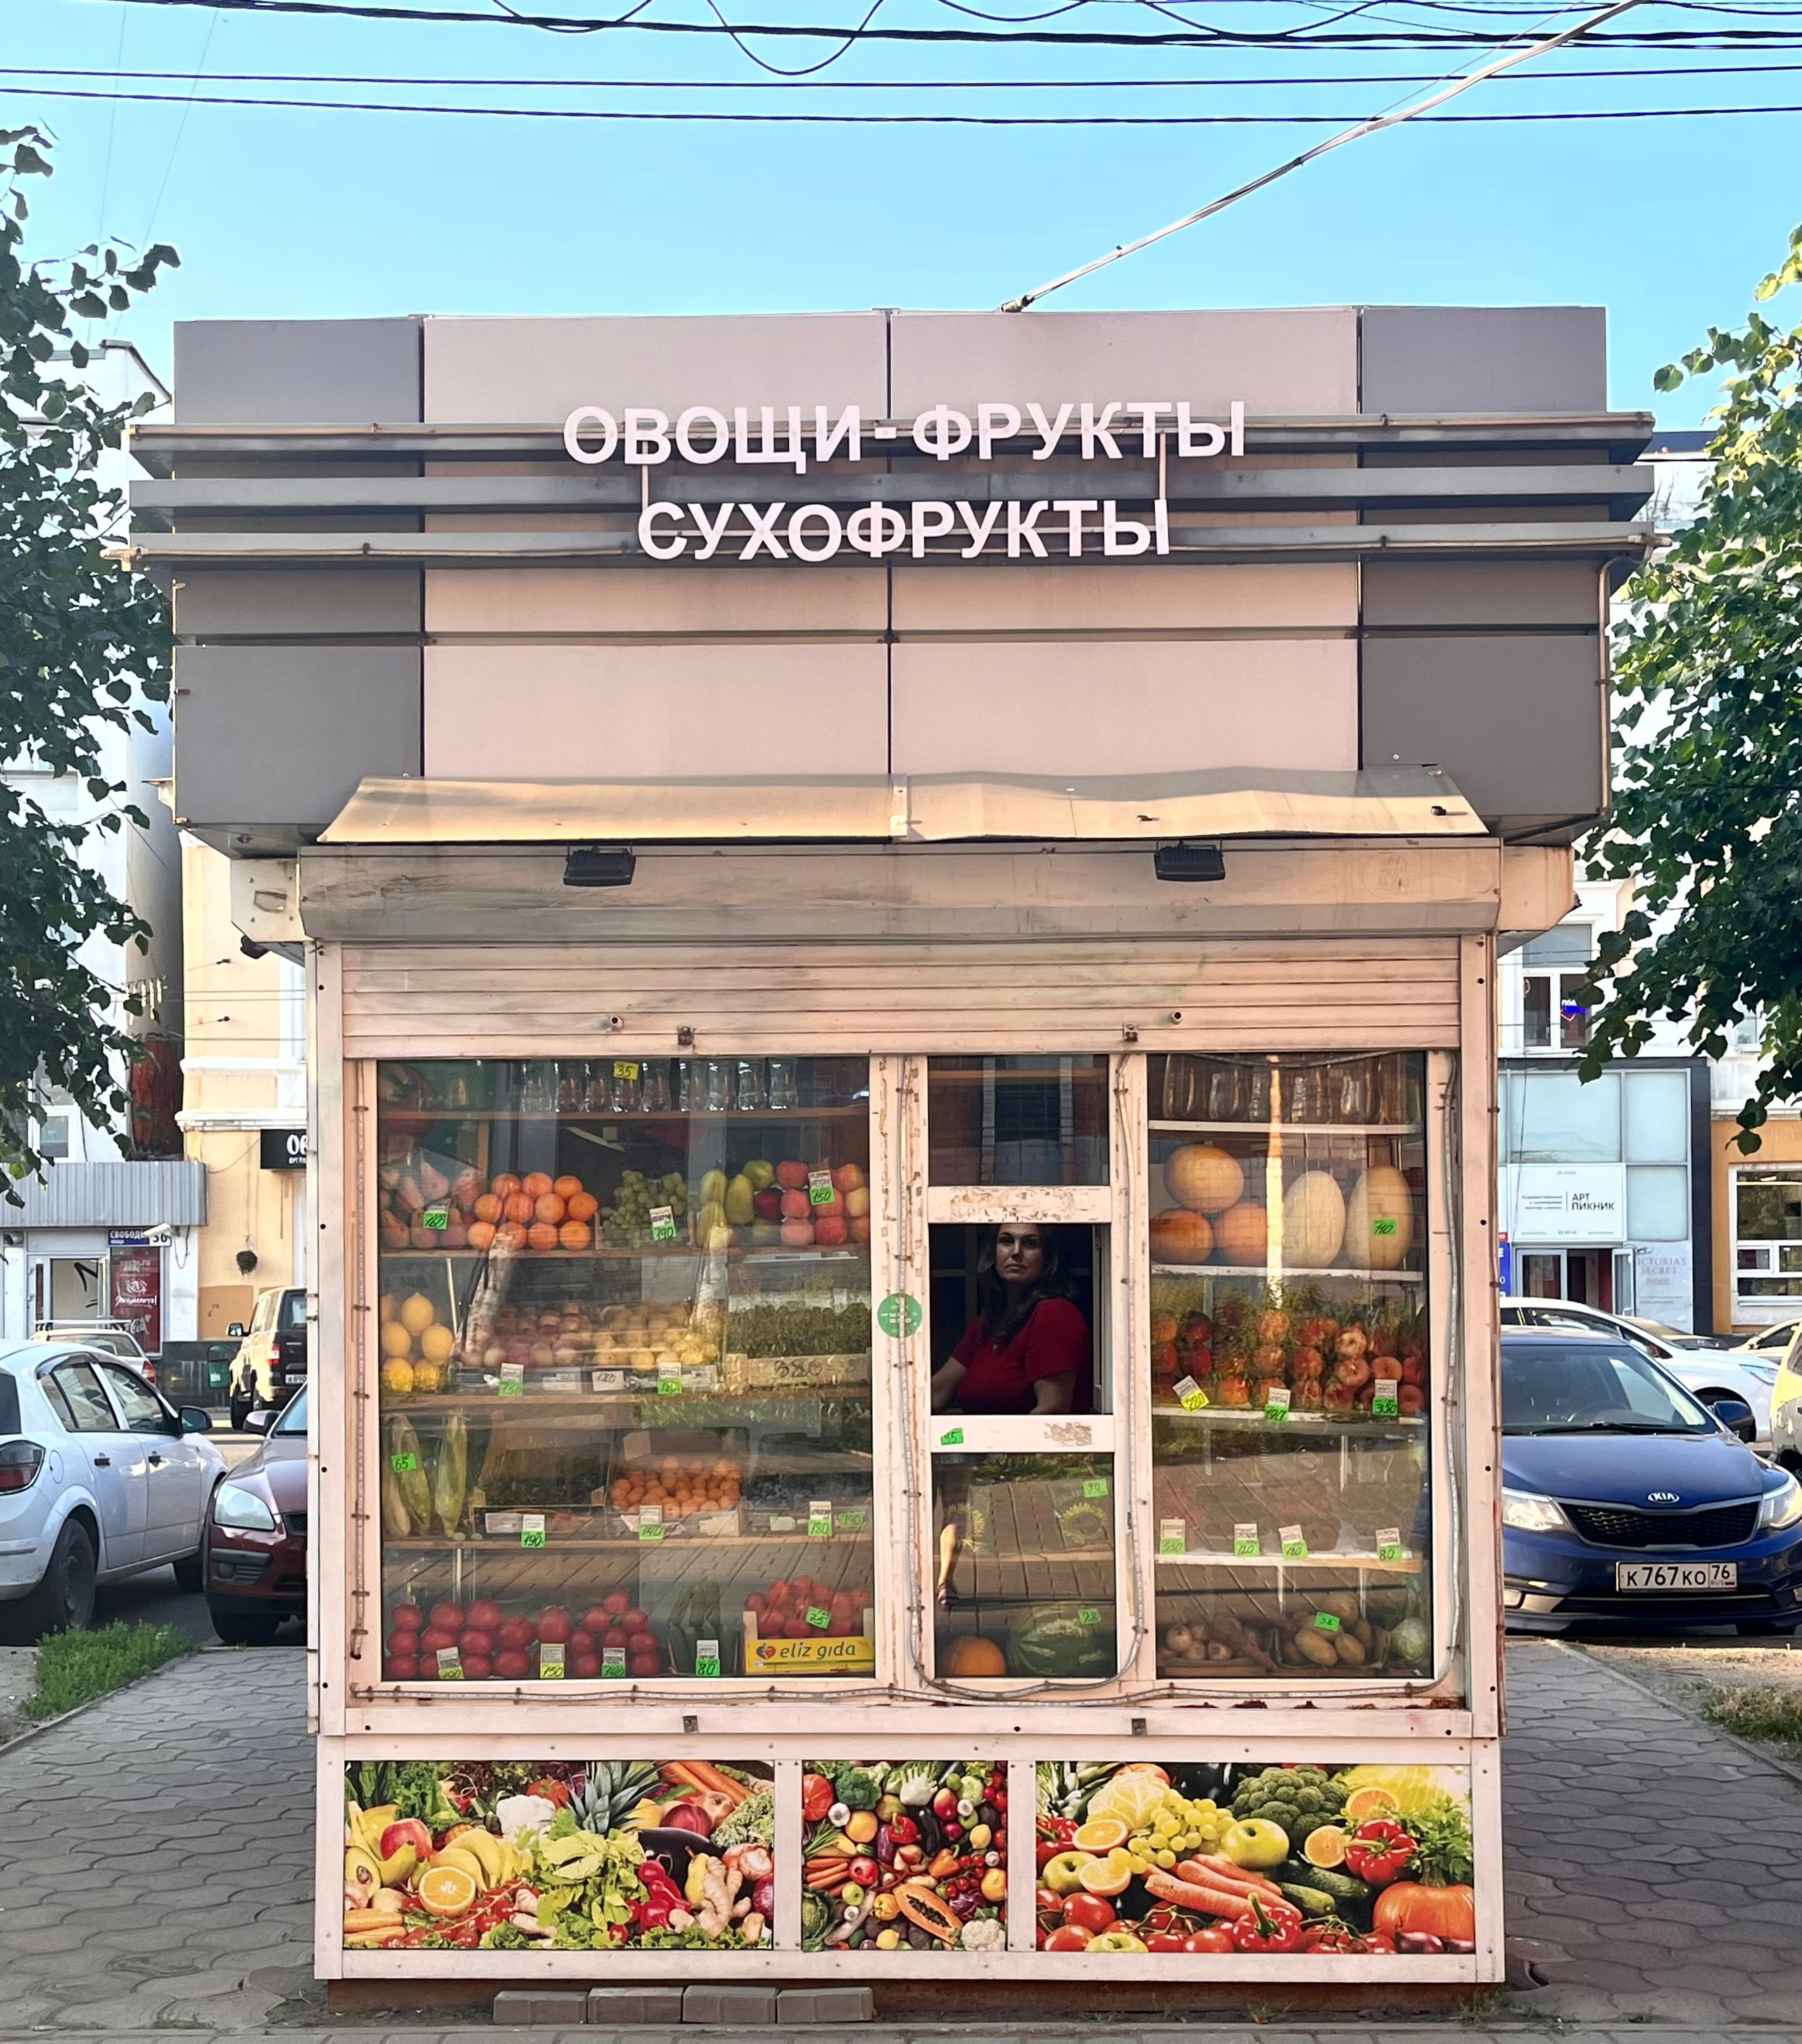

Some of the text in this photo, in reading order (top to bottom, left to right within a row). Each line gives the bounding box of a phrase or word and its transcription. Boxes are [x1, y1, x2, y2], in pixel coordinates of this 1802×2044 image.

[638, 499, 1169, 562] СУХОФРУКТЫ
[617, 1065, 636, 1077] 35
[1572, 1202, 1615, 1210] ПИКНИК
[396, 1457, 409, 1470] 65
[524, 1534, 542, 1547] 190
[1380, 1549, 1395, 1561] 80
[1712, 1565, 1730, 1579] 76
[780, 1642, 812, 1658] eliz
[543, 1667, 563, 1677] 150
[698, 1664, 716, 1675] 80
